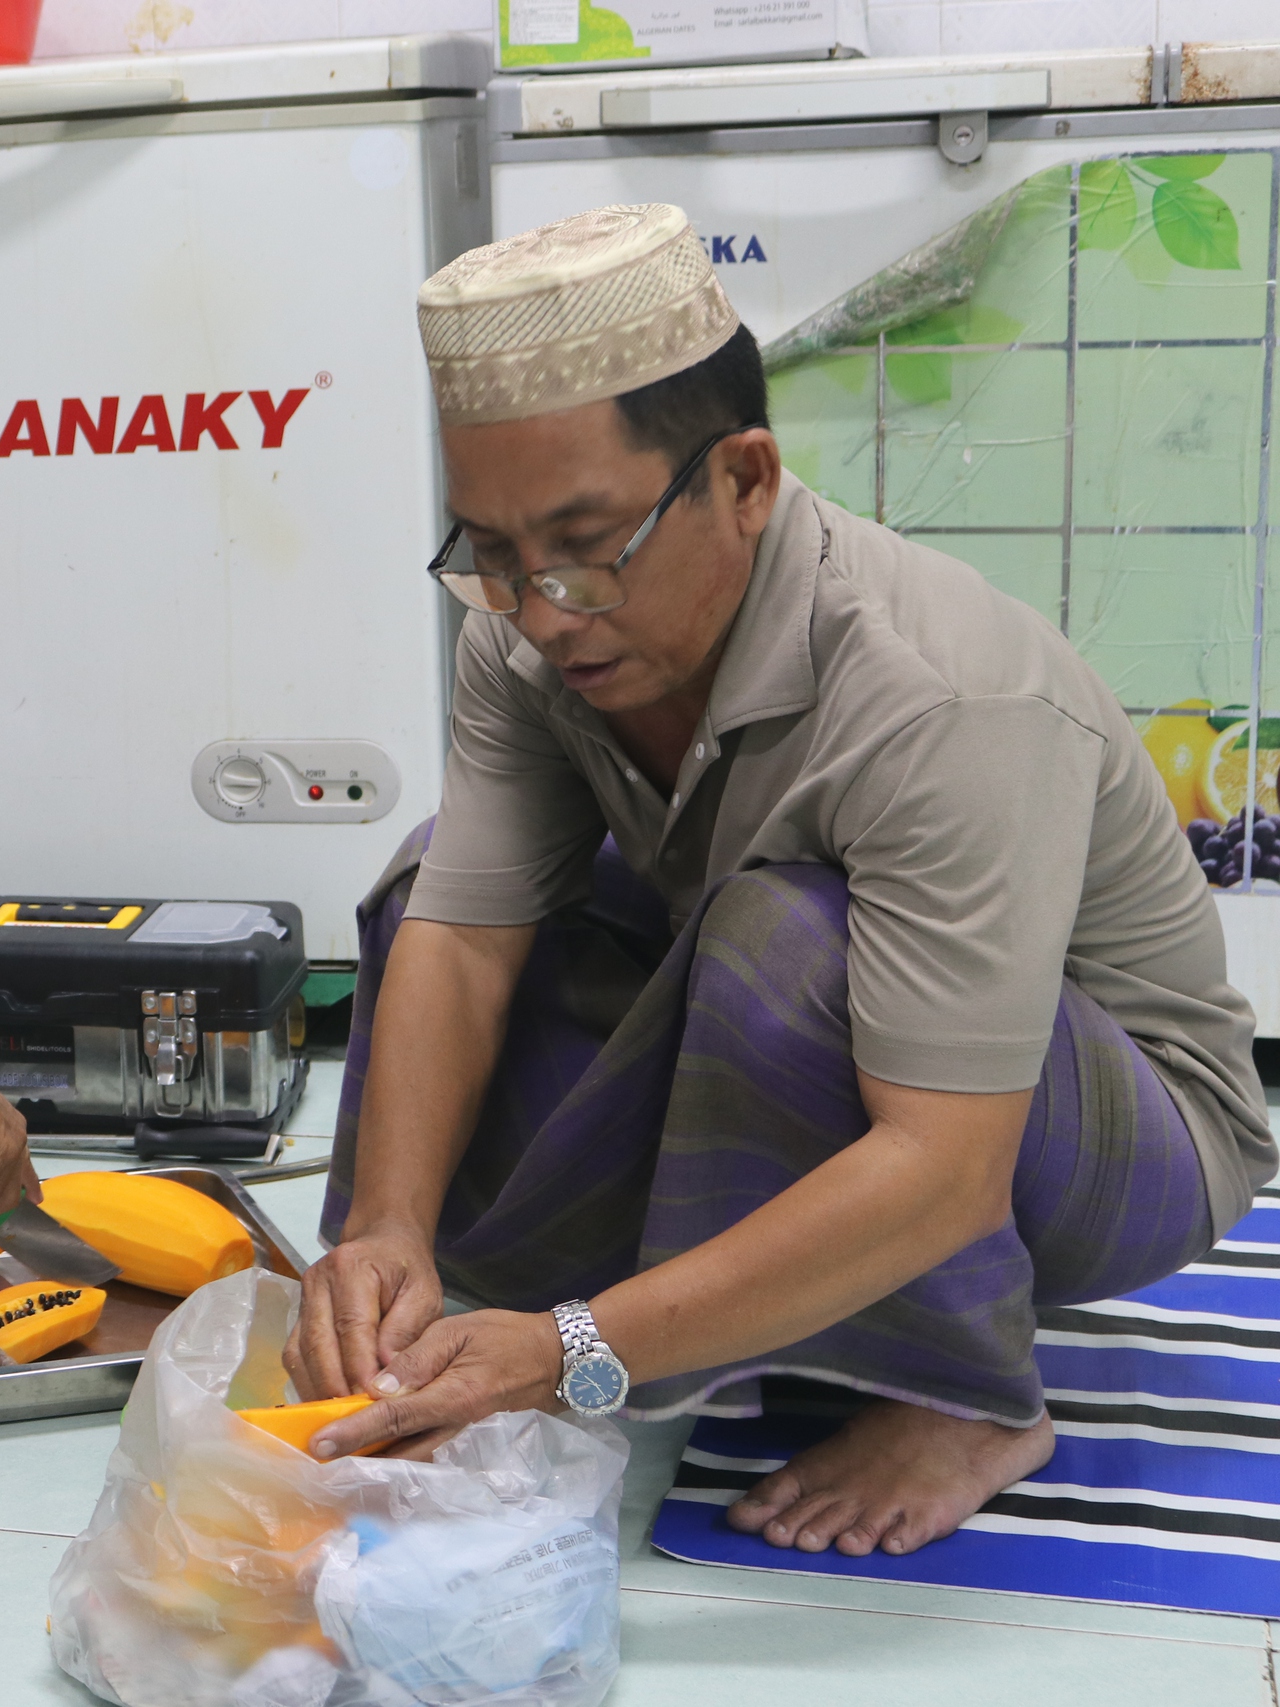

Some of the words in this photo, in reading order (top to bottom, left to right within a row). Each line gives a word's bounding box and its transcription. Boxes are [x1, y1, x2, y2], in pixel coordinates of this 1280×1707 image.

[714, 19, 733, 28] Email
[636, 26, 672, 36] ALGERIAN
[673, 24, 696, 34] DATES
[305, 769, 326, 778] POWER
[349, 769, 358, 778] ON
